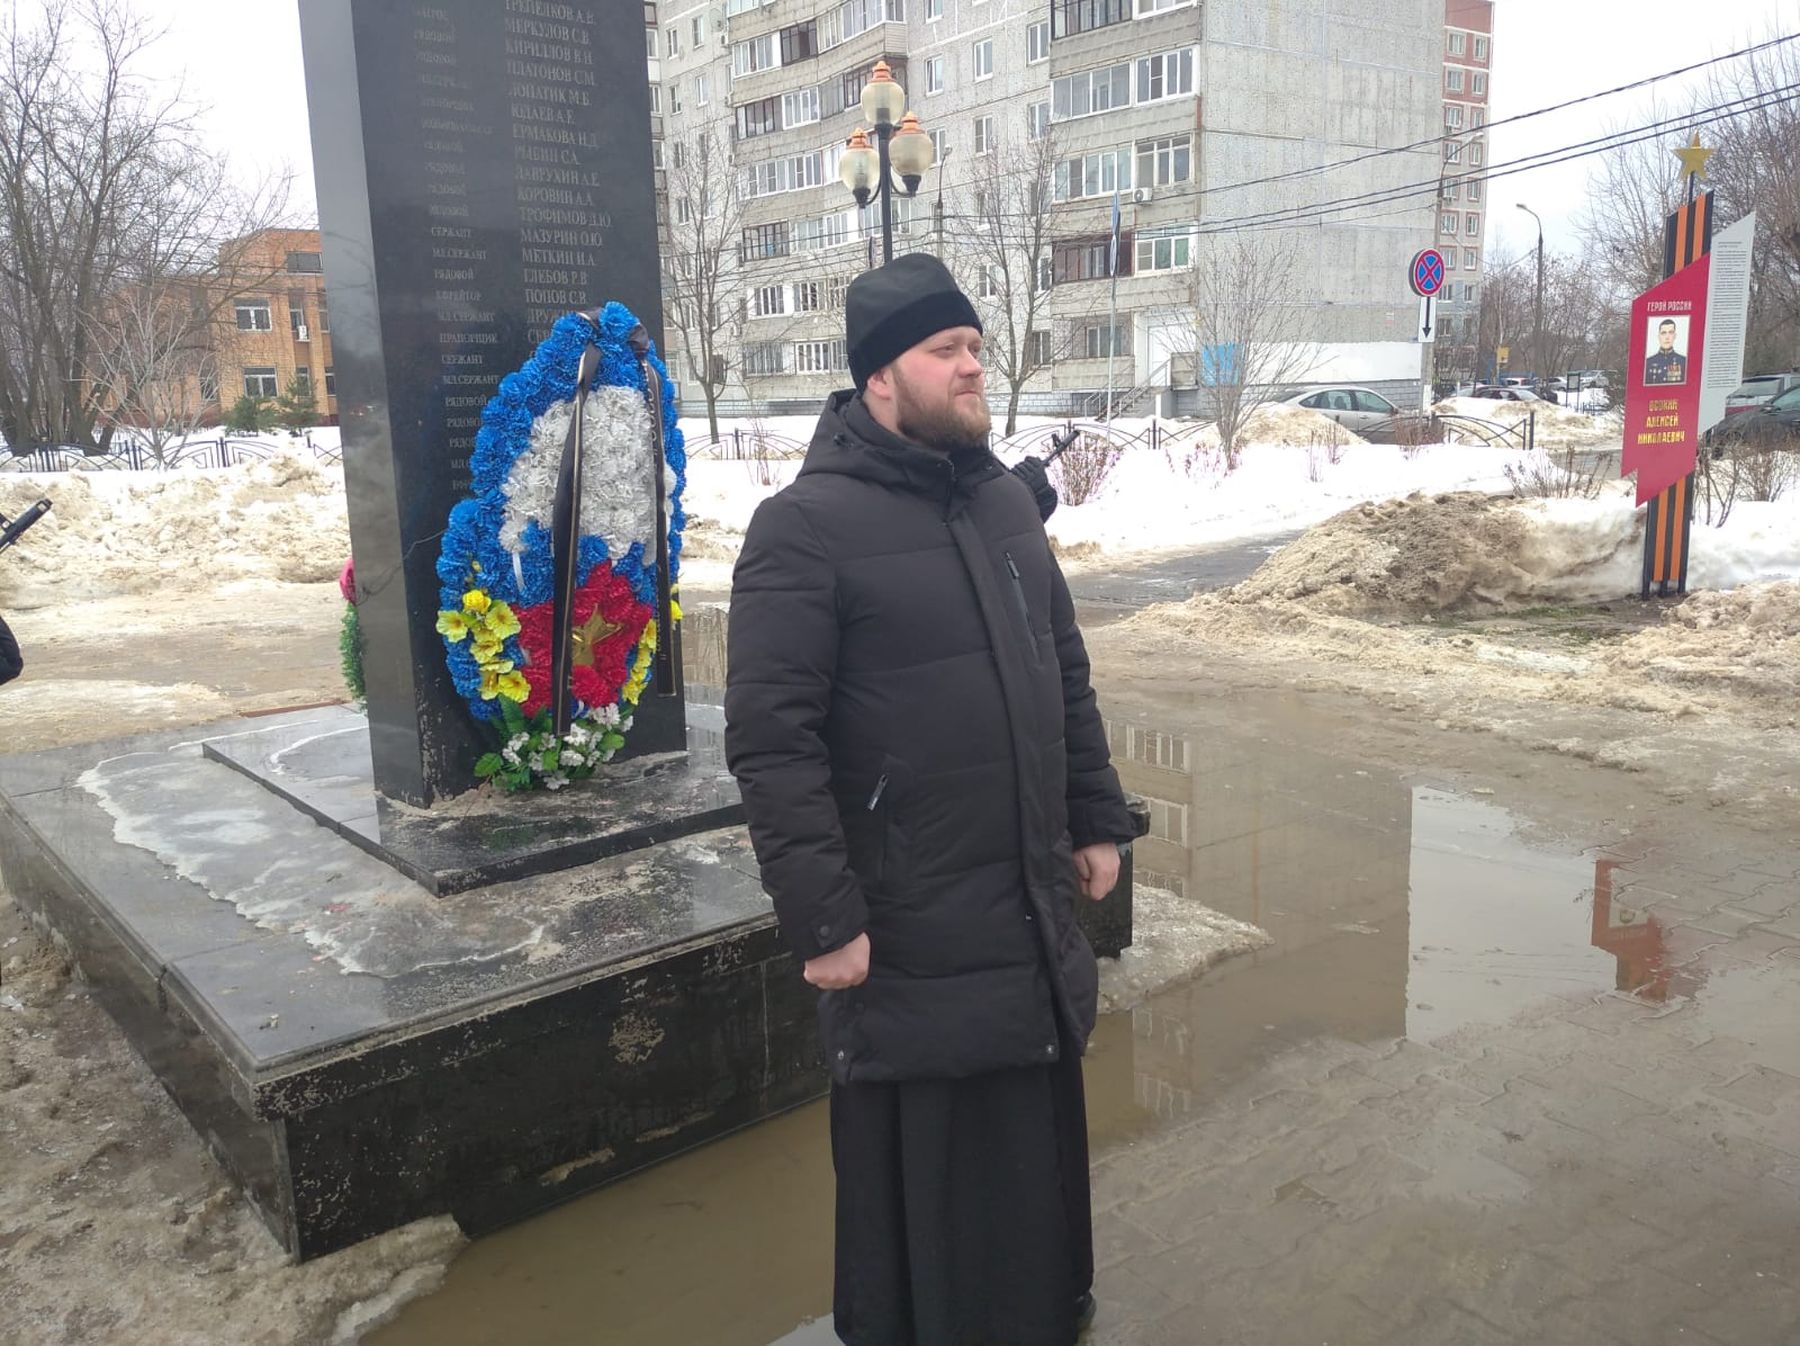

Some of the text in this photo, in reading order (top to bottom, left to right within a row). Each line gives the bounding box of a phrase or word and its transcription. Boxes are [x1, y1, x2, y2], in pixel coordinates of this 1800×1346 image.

[504, 17, 569, 41] МЕРКУЛОВ
[504, 39, 570, 62] КИРИЛЛОВ
[505, 59, 572, 83] ПЛАТОНОВ
[512, 123, 576, 145] ЕРМАКОВА
[517, 186, 573, 205] КОРОВИН
[519, 207, 586, 226] ТРОФИМОВ
[520, 228, 578, 246] МАЗУРИН
[521, 248, 574, 266] МЕТКИН
[523, 268, 568, 286] ГЛЕБОВ
[525, 288, 567, 305] ПОПОВ
[1667, 299, 1692, 311] РОССИИ
[440, 332, 497, 345] ПРАПОРЩИК
[441, 354, 483, 365] СЕРЖАНТ
[445, 394, 487, 407] РЯДОВОЙ
[447, 417, 481, 428] РЯДОВО
[1646, 412, 1679, 428] АЛЕКСЕЙ
[1637, 430, 1685, 445] НИКОЛАЕВИЧ
